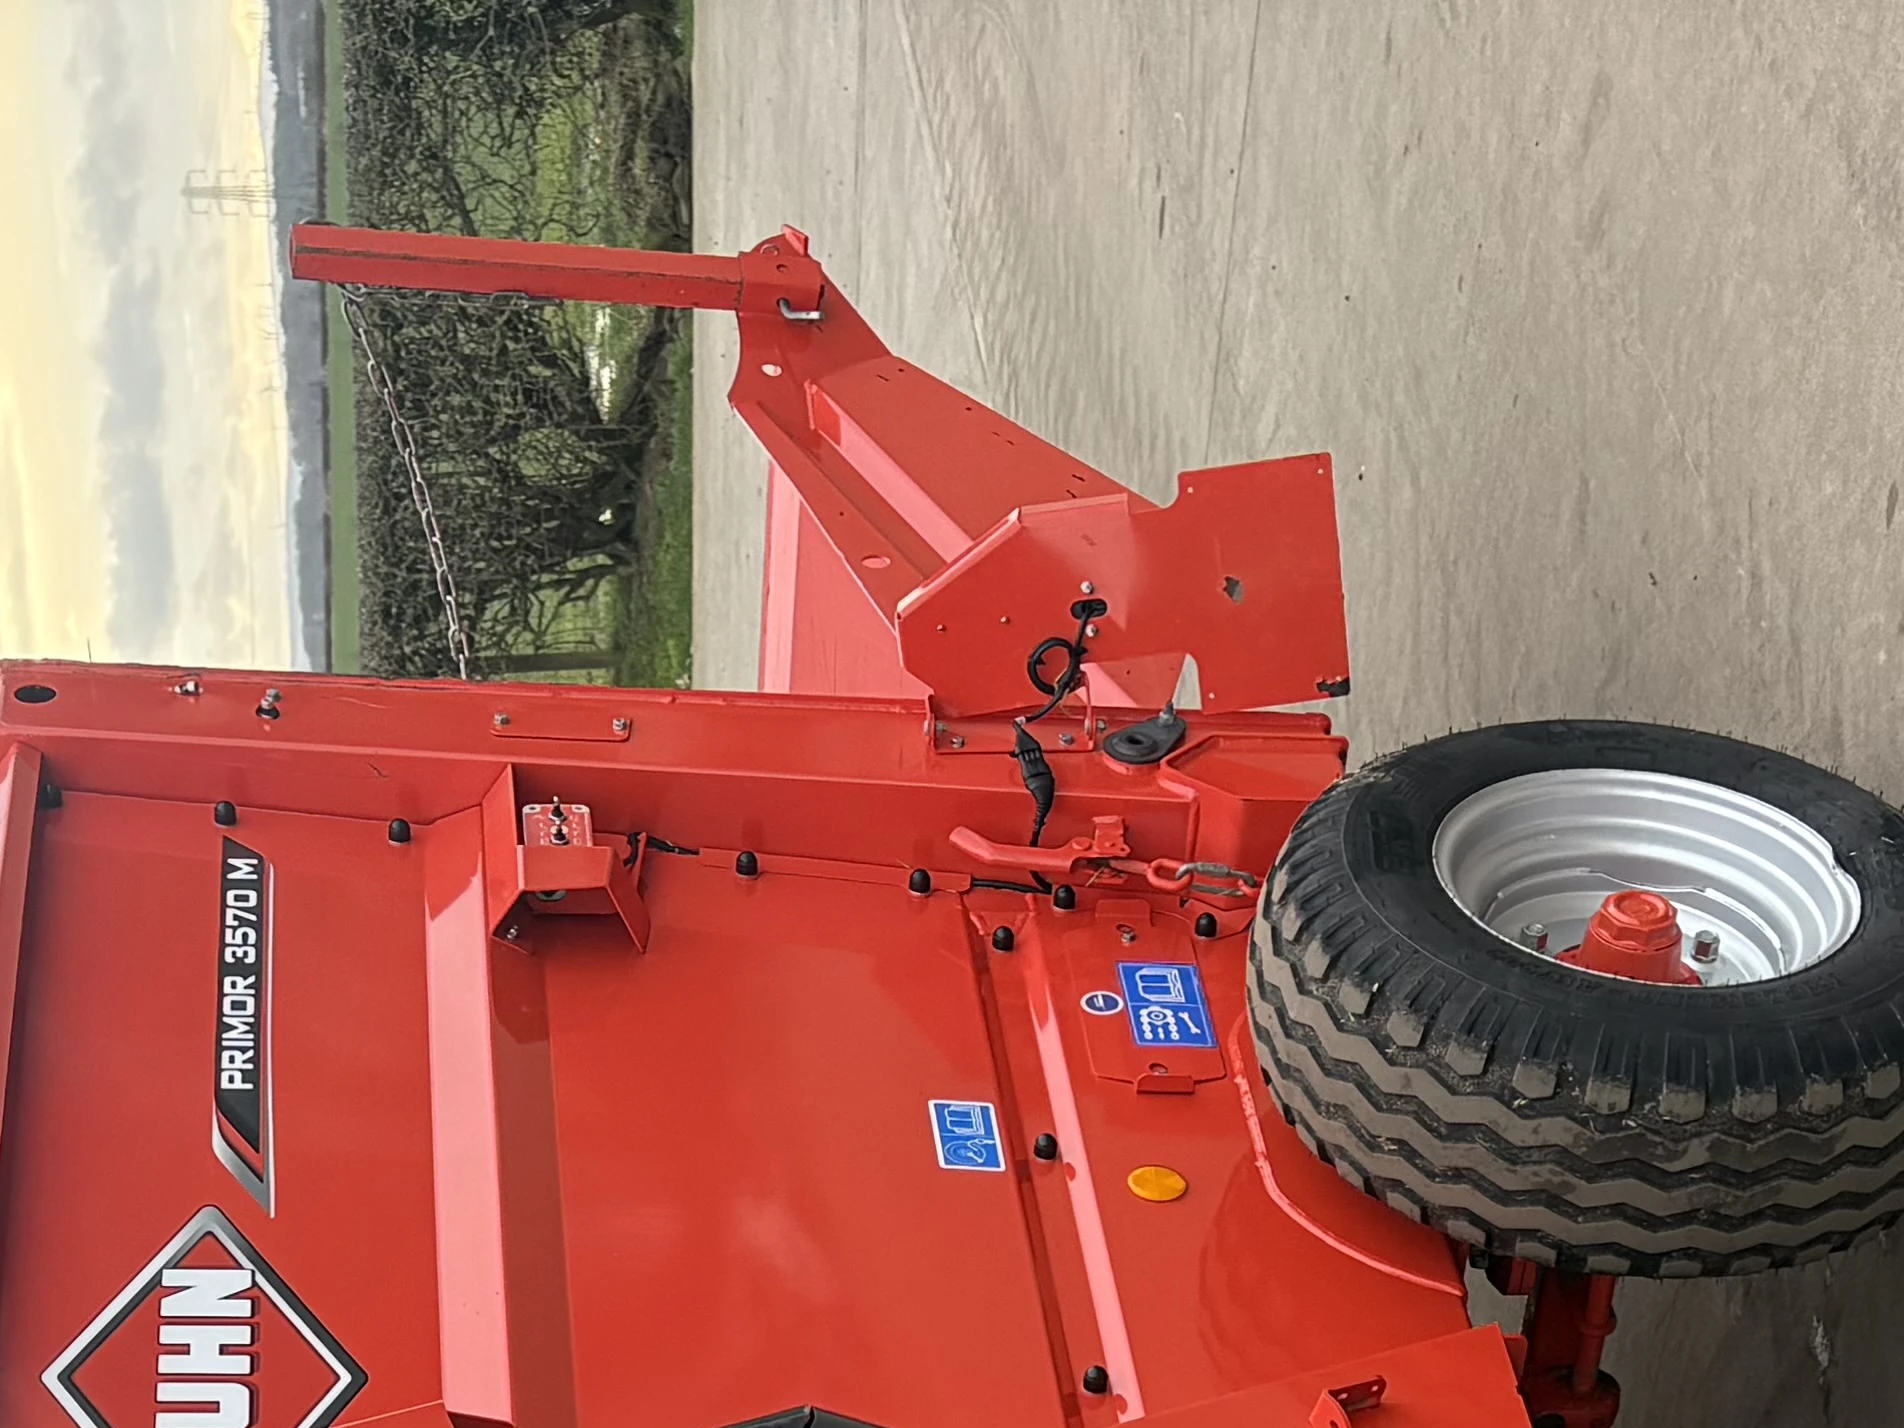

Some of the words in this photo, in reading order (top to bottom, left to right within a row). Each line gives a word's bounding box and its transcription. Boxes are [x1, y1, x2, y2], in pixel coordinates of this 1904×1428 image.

[226, 858, 259, 880] M
[224, 889, 257, 964] 3570
[221, 975, 256, 1090] PRIMOR
